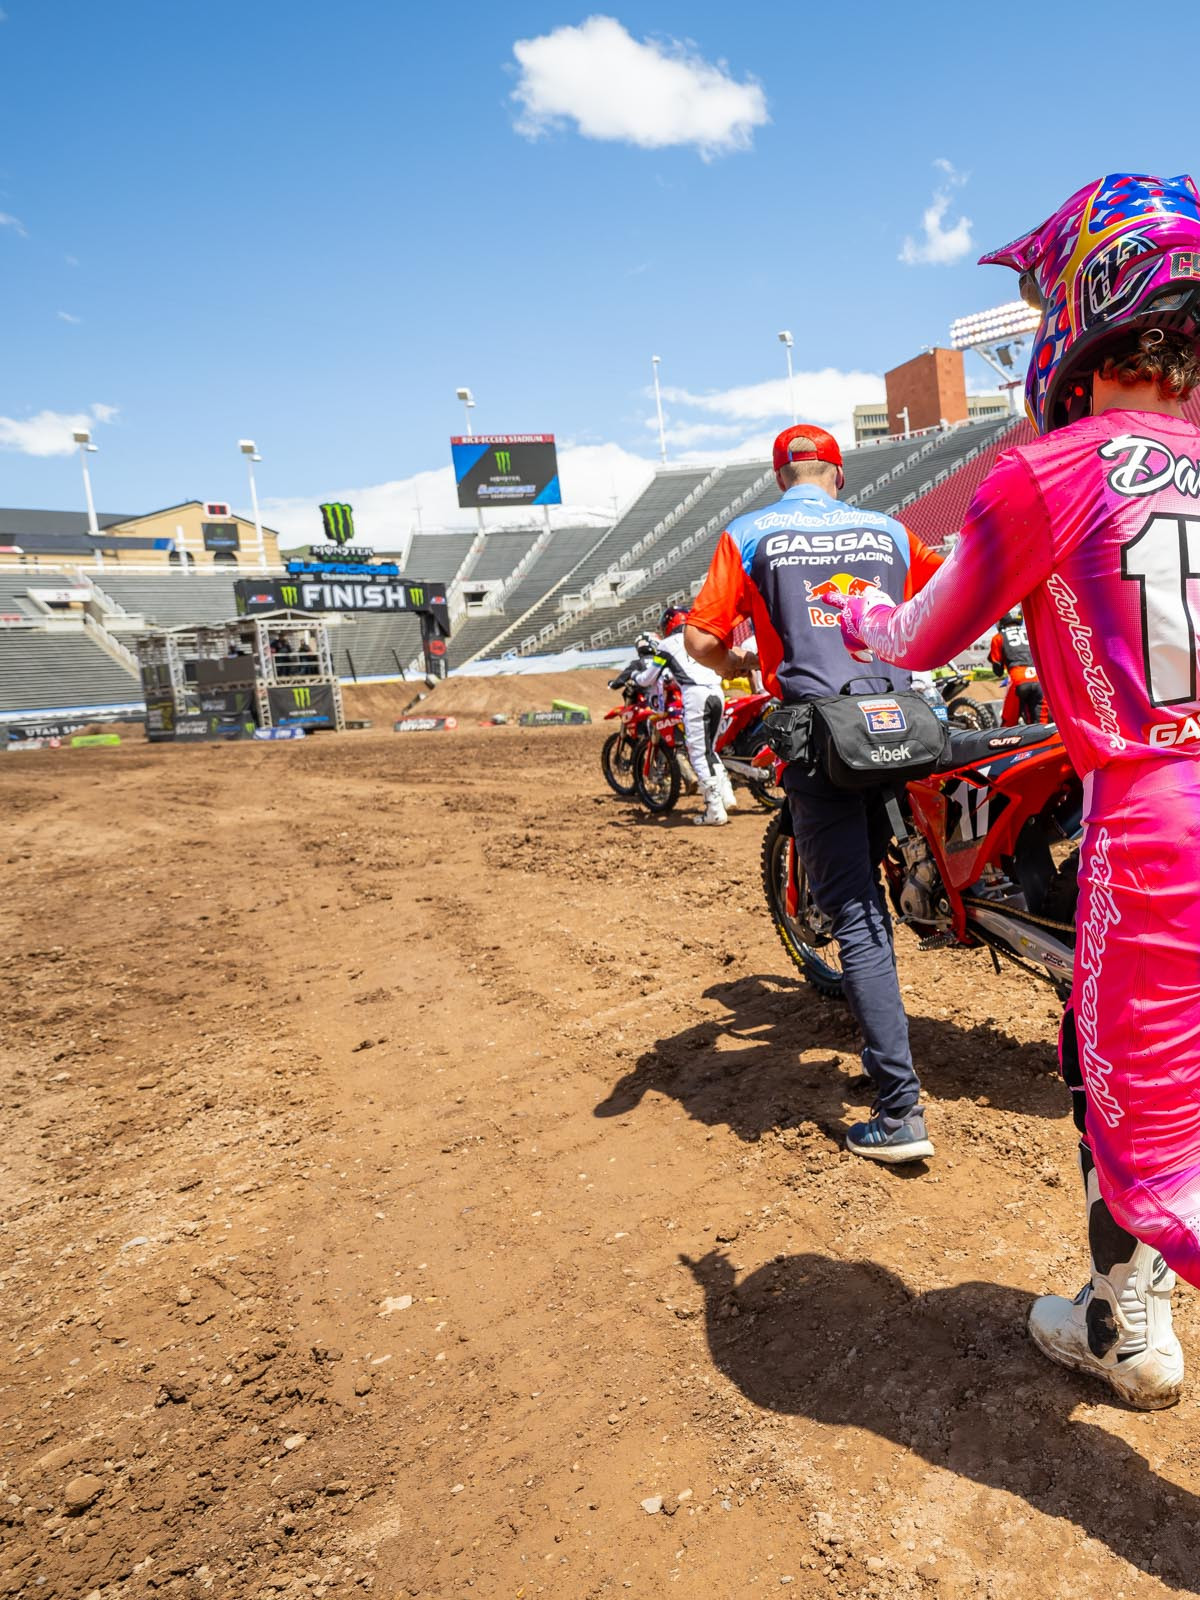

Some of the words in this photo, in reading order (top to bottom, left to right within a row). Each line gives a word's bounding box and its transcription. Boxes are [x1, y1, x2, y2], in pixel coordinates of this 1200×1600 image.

[461, 436, 508, 444] RICE-ECCLES
[508, 435, 544, 443] STADIUM
[312, 545, 375, 557] MONSTER
[766, 532, 893, 556] GASGAS
[770, 555, 842, 571] FACTORY
[843, 552, 894, 566] RACING
[302, 584, 407, 608] FINISH
[1047, 573, 1080, 626] Troy
[1069, 623, 1093, 668] Lee
[25, 725, 60, 737] UTAH
[989, 736, 1022, 747] GUTS
[1077, 974, 1098, 1050] Lee
[1082, 1045, 1127, 1128] Troy
